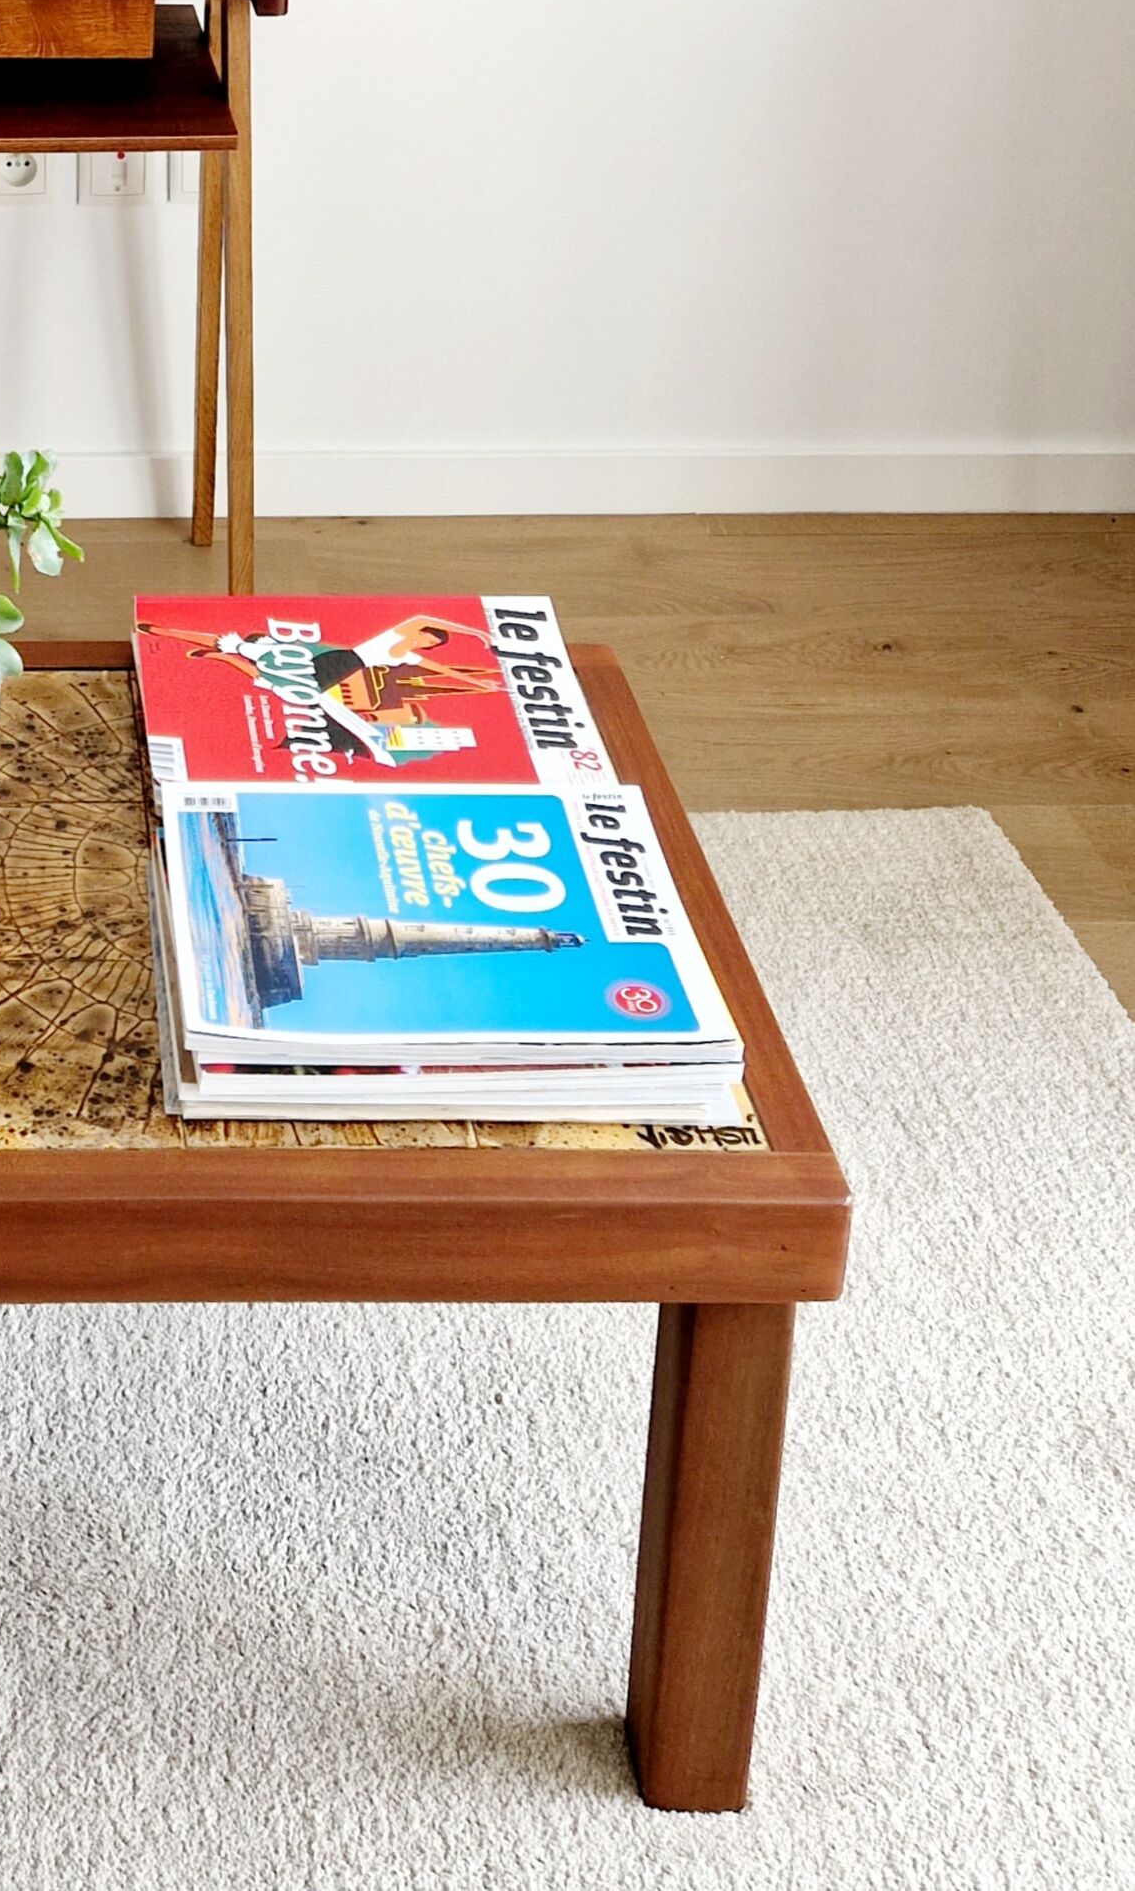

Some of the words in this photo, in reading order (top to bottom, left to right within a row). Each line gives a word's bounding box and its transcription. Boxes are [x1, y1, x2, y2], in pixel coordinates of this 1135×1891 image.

[494, 608, 547, 642] le
[490, 645, 585, 749] festin
[385, 802, 430, 907] d'œuvre
[584, 802, 626, 830] le
[421, 830, 466, 908] chefs-
[457, 819, 567, 913] 30
[580, 832, 668, 935] festin
[620, 988, 658, 1013] 30
